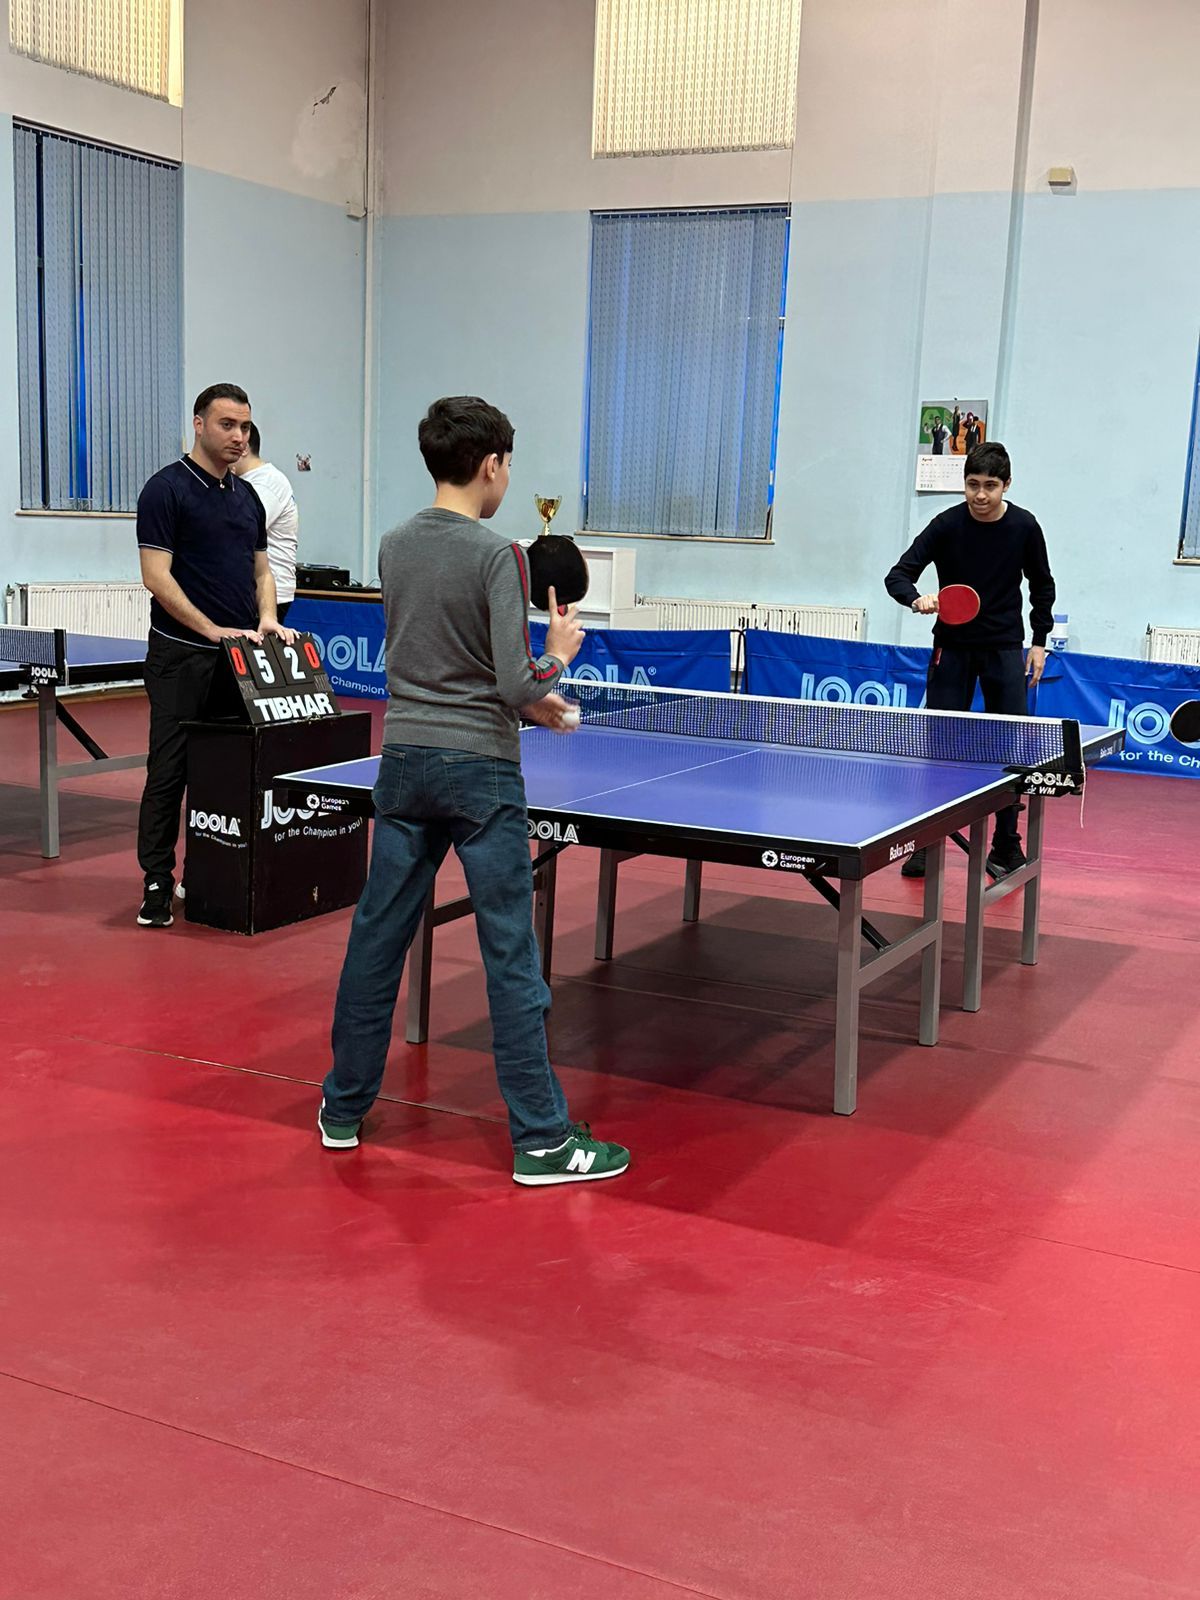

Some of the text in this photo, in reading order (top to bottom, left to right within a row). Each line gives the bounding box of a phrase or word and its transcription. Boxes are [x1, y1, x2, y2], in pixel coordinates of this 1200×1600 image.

[229, 641, 320, 684] 0 5 2 0
[31, 666, 58, 679] JOOLA
[331, 675, 385, 695] Champion
[253, 692, 334, 722] TIBHAR
[1119, 750, 1143, 761] for
[1147, 750, 1174, 763] the
[321, 803, 342, 811] Games
[189, 809, 241, 837] JOOLA
[274, 832, 285, 842] for
[288, 828, 300, 837] the
[303, 826, 338, 839] Champion
[340, 826, 346, 835] in
[779, 861, 806, 870] Games
[780, 852, 815, 864] European
[566, 1148, 597, 1174] N
